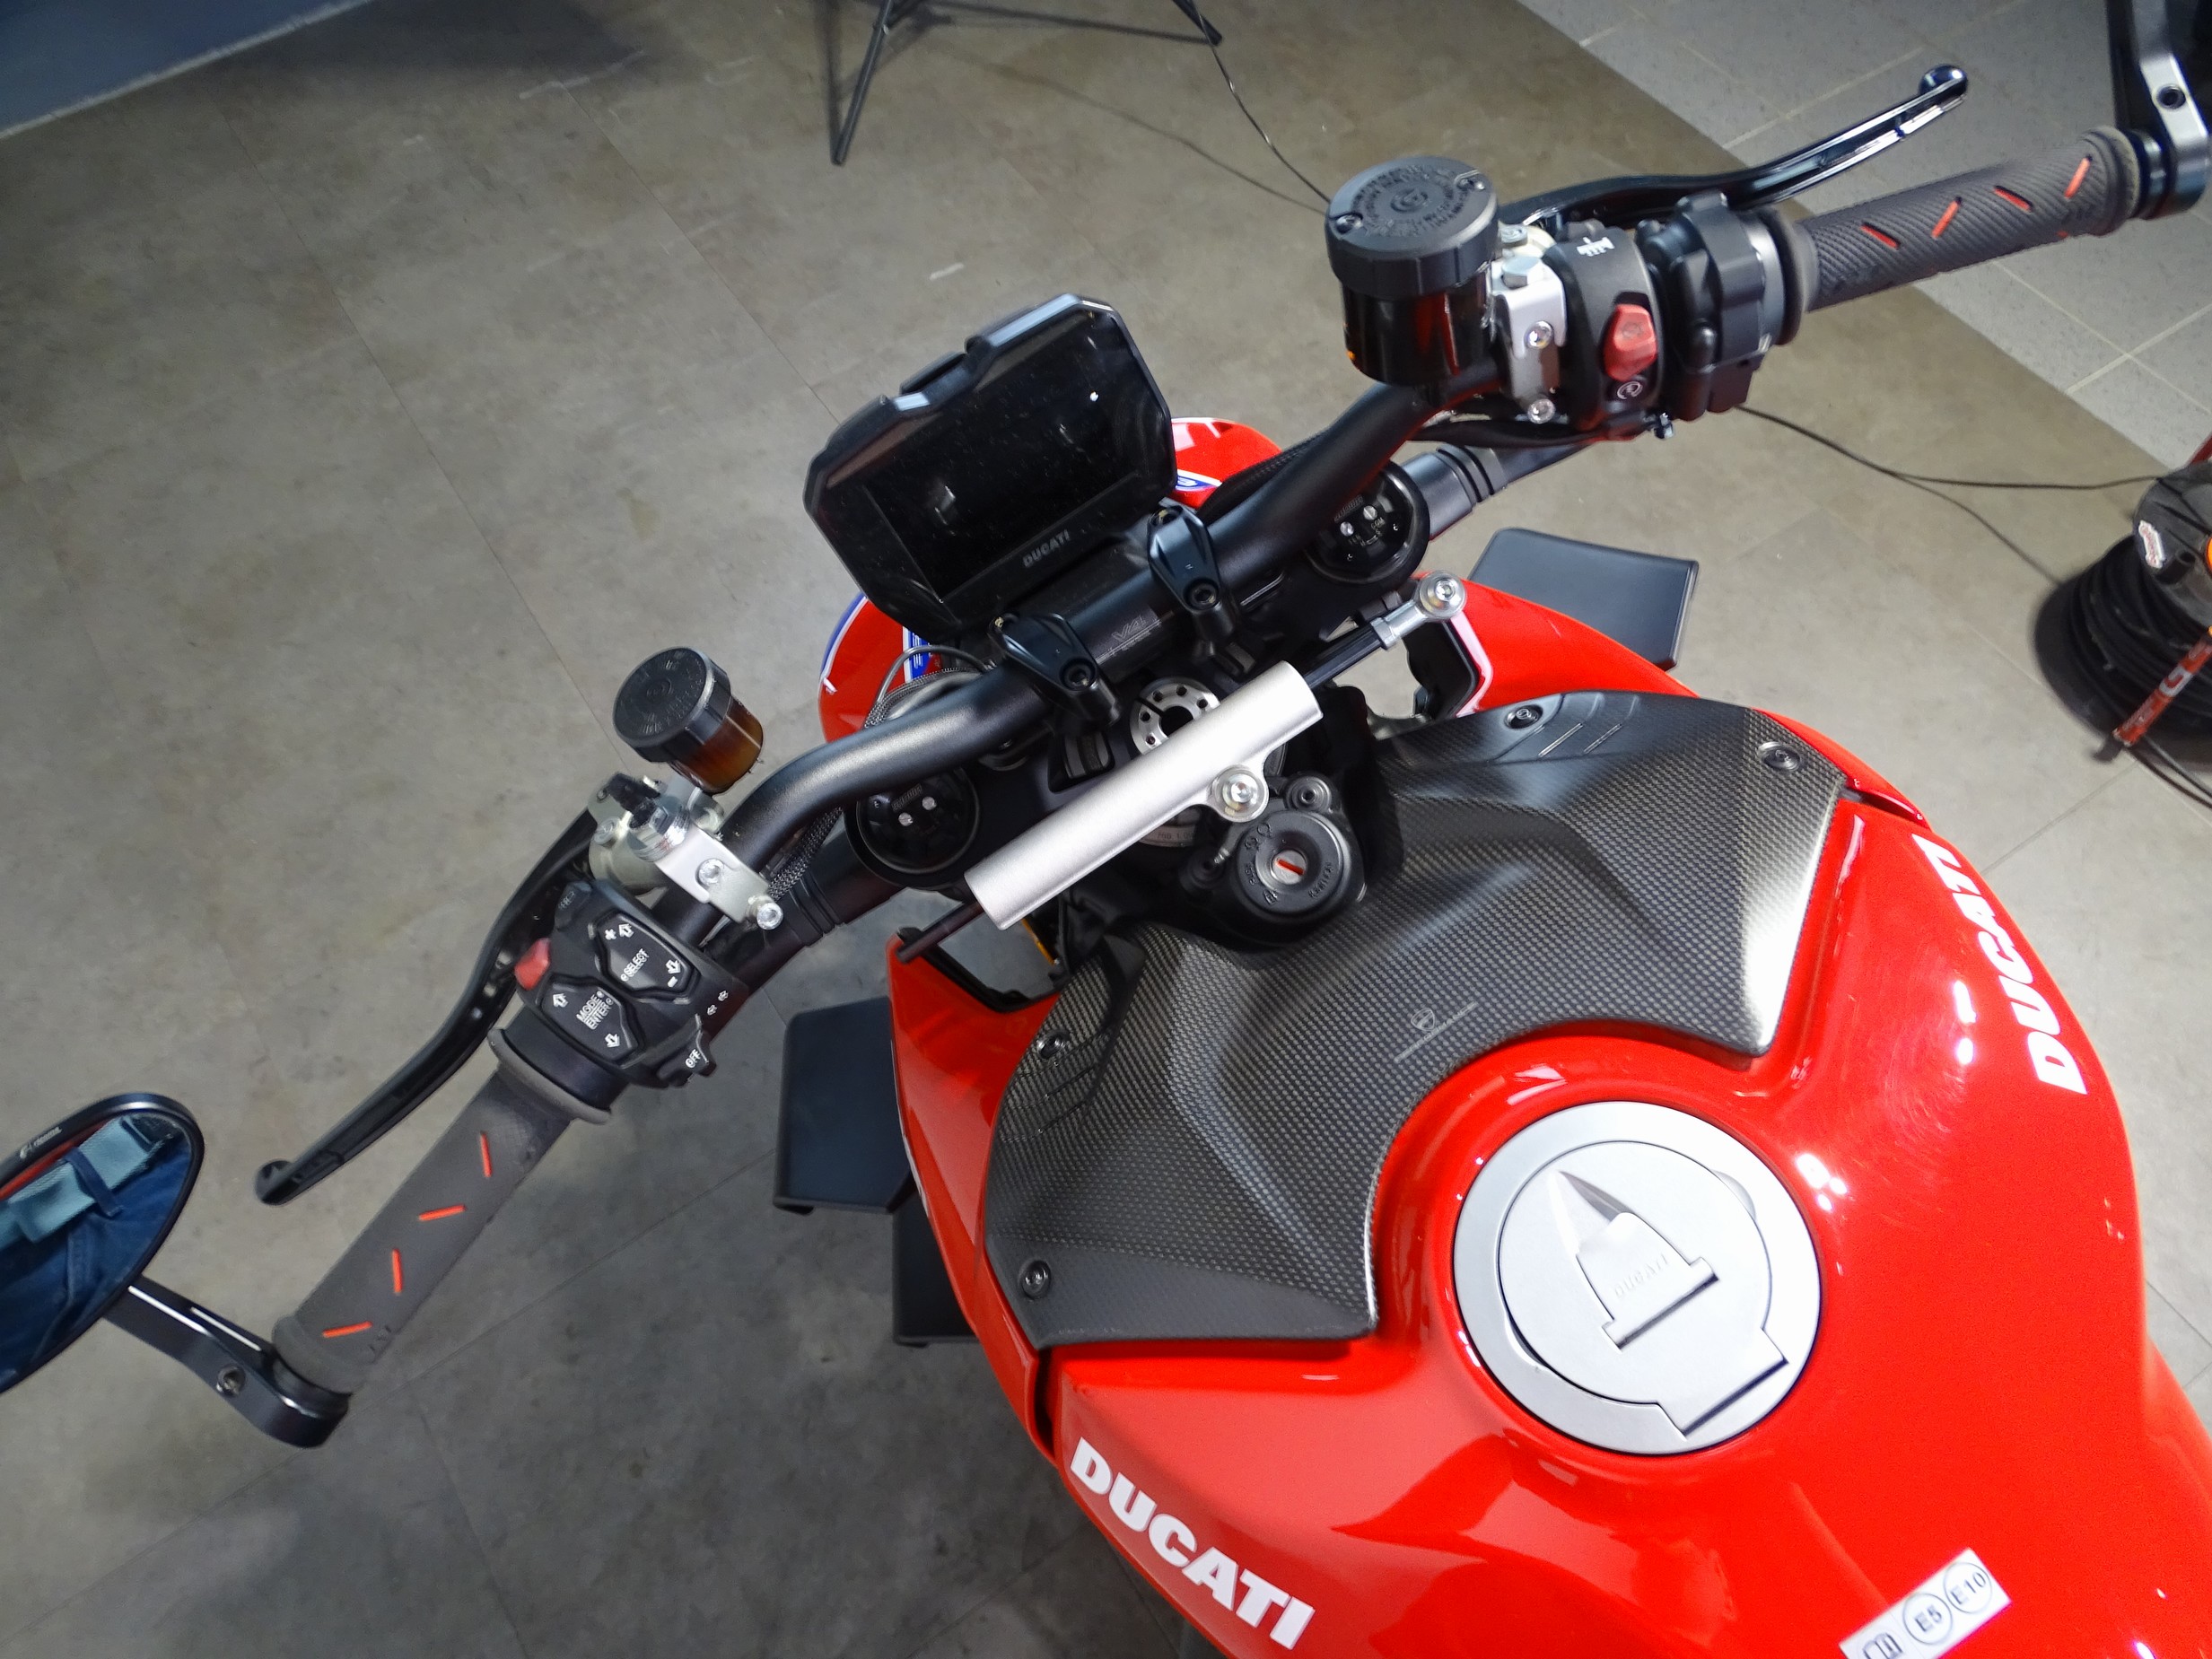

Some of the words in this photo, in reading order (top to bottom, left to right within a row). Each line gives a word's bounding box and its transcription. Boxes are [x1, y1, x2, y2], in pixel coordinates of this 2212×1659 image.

[1021, 528, 1071, 568] DUCATI
[624, 947, 650, 977] SELECT
[1911, 834, 2087, 1095] DUCATI
[576, 994, 600, 1023] MODE
[584, 1000, 612, 1030] ENTER
[685, 1049, 701, 1069] OFF
[1613, 1253, 1670, 1300] DUCATI
[1071, 1436, 1316, 1650] DUCATI
[1913, 1603, 1943, 1632] E5
[1949, 1571, 1987, 1605] E10
